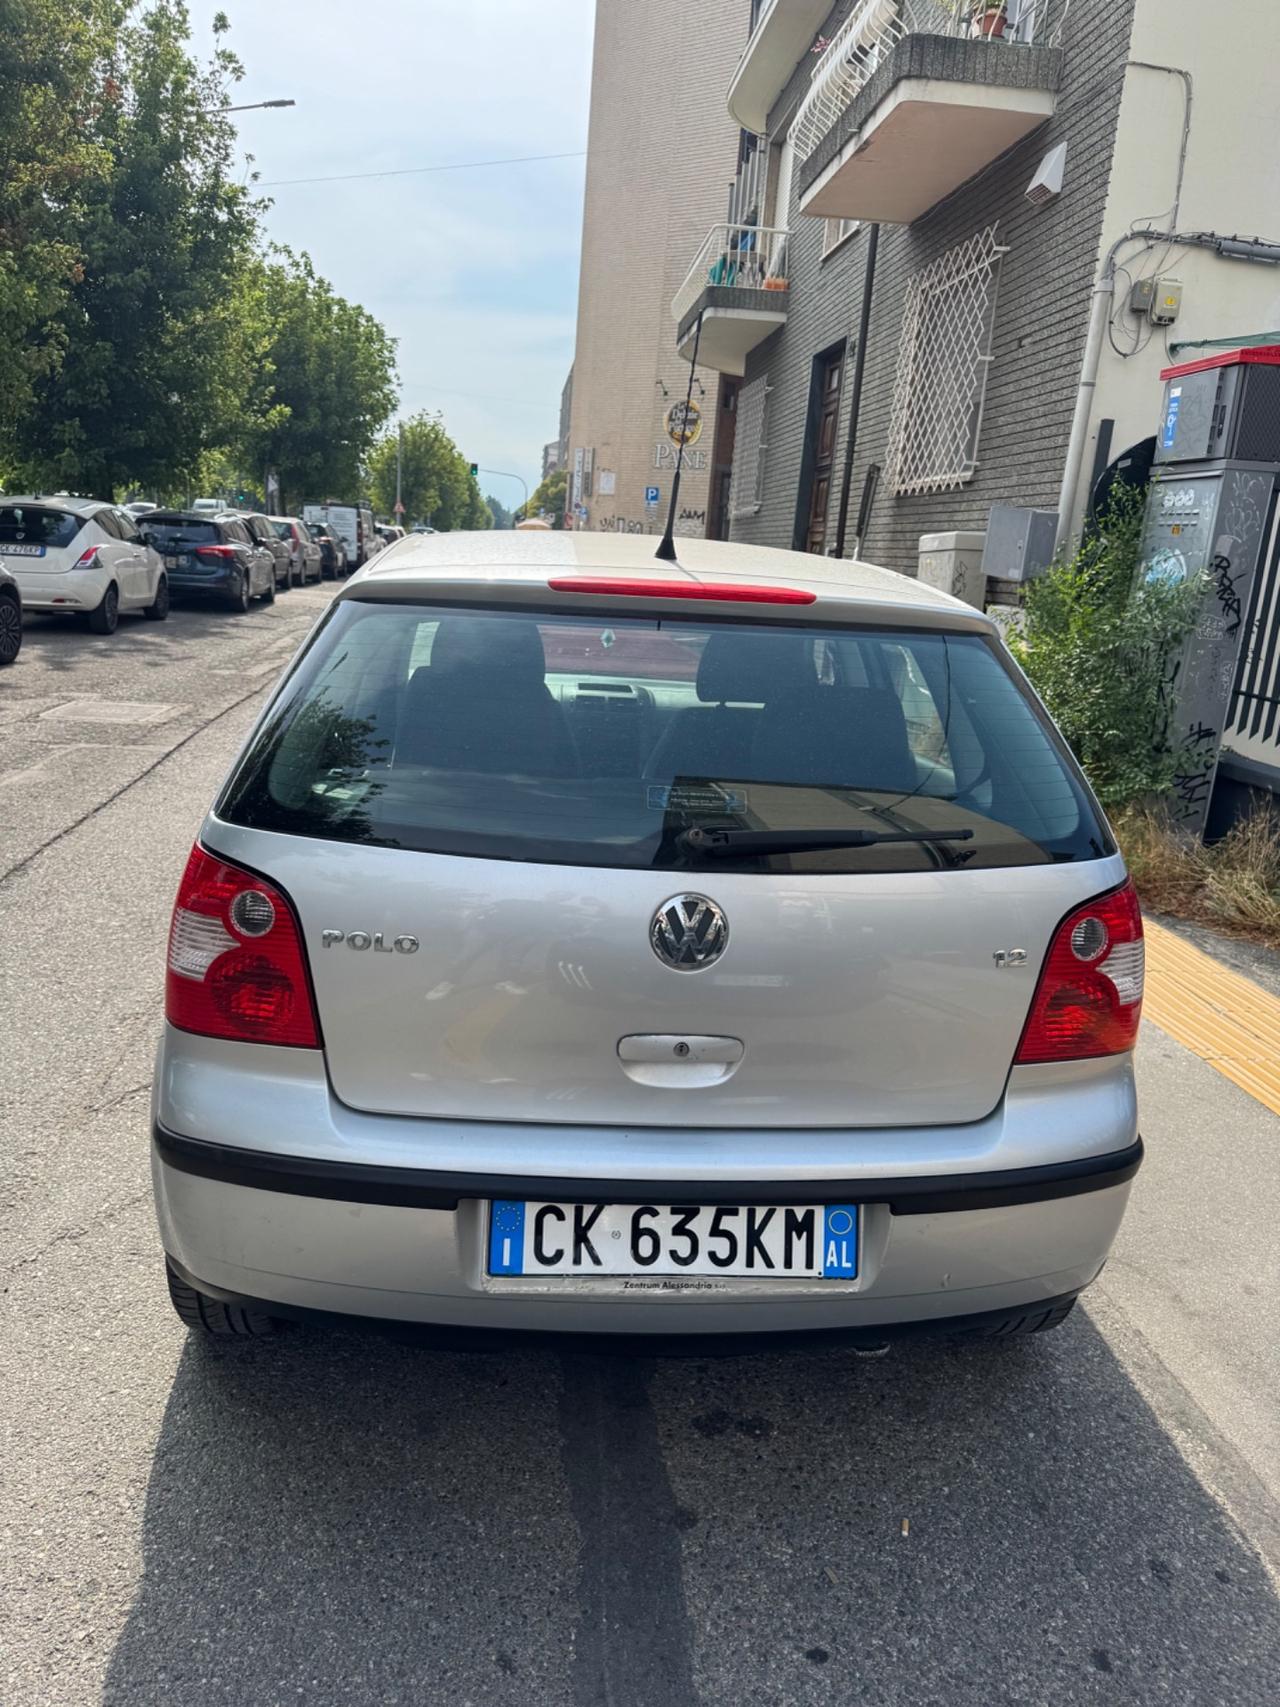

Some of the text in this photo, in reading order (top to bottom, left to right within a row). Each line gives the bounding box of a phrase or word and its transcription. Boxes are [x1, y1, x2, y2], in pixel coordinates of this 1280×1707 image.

[655, 444, 706, 468] PANE
[648, 488, 657, 500] P
[322, 929, 419, 954] POLO
[503, 1204, 852, 1270] I CK 635KM AL
[623, 1281, 660, 1289] Zentrum
[661, 1281, 712, 1290] Alessandria
